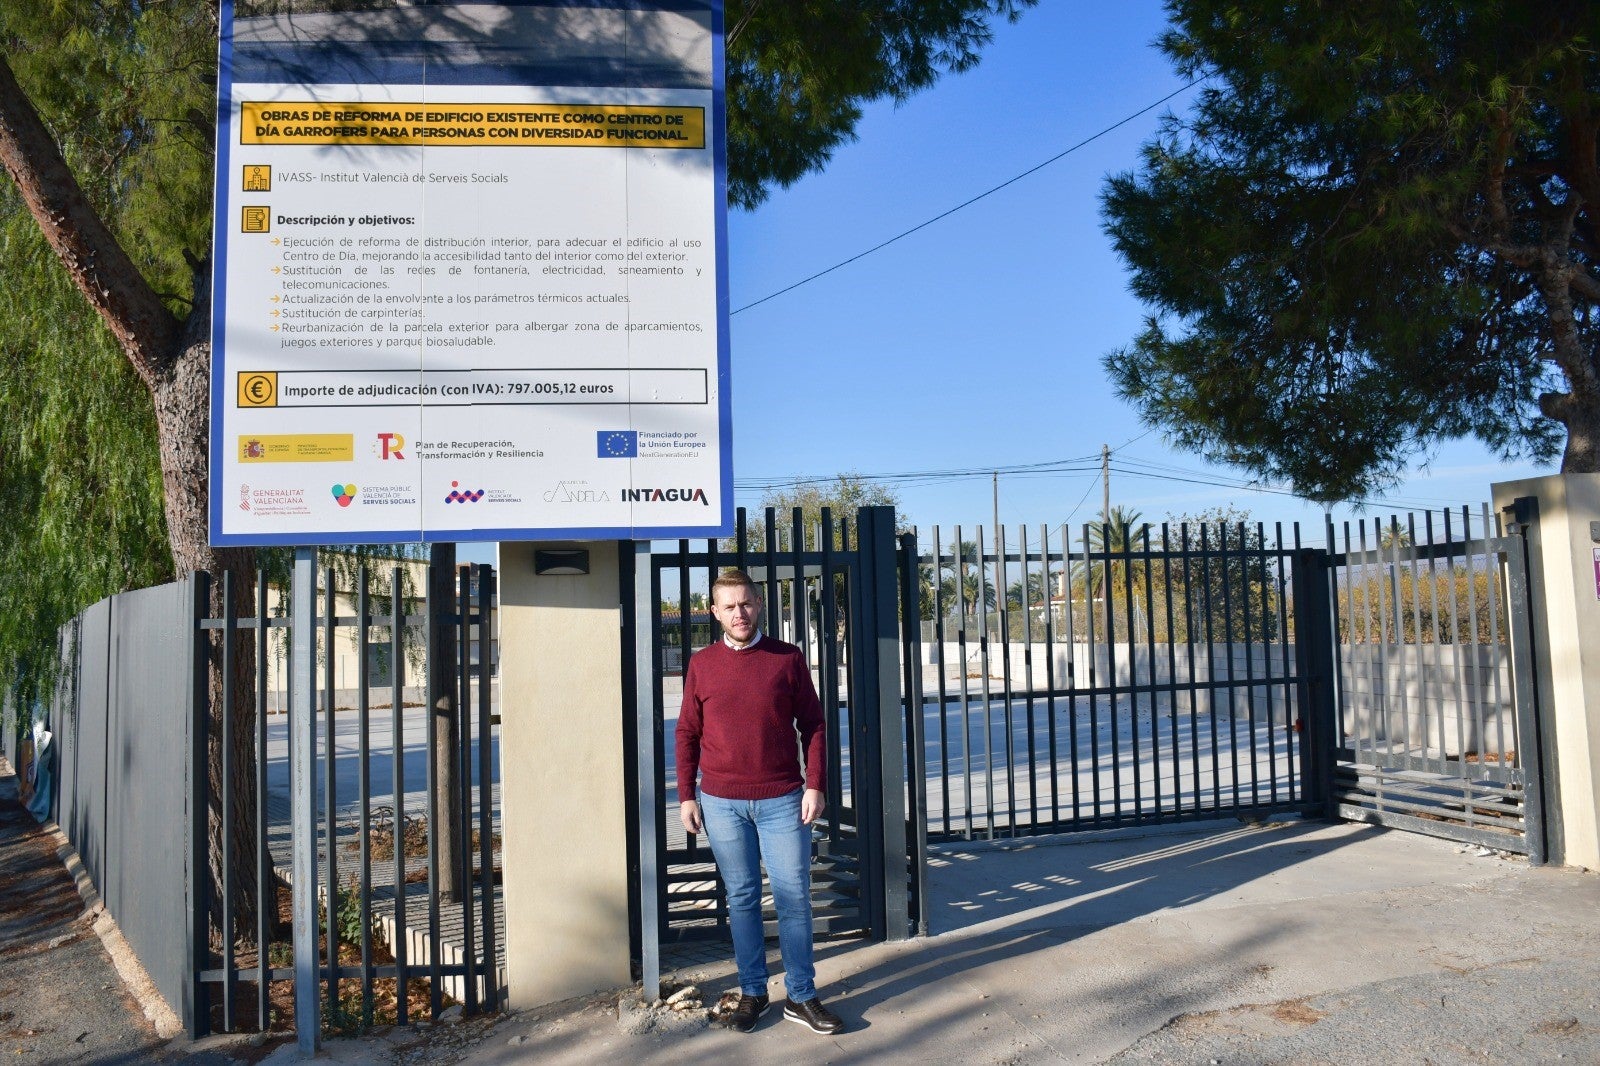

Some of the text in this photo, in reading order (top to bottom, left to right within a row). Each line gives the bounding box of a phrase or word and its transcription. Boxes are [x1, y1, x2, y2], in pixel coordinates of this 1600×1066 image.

[261, 111, 683, 125] OBRAS DE REFORMA DE EDIFICIO EXISTENTE COMO CENTRO DE
[256, 124, 280, 136] DÍA
[283, 126, 368, 137] GARROFERS
[371, 127, 407, 137] PARA
[413, 127, 485, 138] PERSONAS
[489, 128, 518, 138] CON
[521, 129, 603, 139] DIVERSIDAD
[279, 173, 509, 183] IVASS- Institut Valencià de Serveis Socials
[278, 215, 415, 227] Descripción y objetivos:
[283, 237, 334, 249] Ejecución
[340, 238, 353, 247] de
[359, 238, 401, 247] reforma
[406, 238, 419, 247] de
[425, 238, 485, 247] distribución
[491, 238, 531, 247] interior,
[537, 240, 560, 249] para
[565, 238, 607, 247] adecuar
[613, 238, 622, 247] el
[627, 238, 663, 247] edificio
[670, 238, 678, 247] al
[283, 252, 318, 261] Centro
[322, 252, 335, 261] de
[339, 252, 359, 262] Día,
[362, 252, 418, 263] mejorando
[422, 252, 431, 261] la
[434, 252, 501, 261] accesibilidad
[504, 253, 532, 261] tanto
[536, 252, 551, 261] del
[555, 252, 591, 261] interior
[627, 252, 642, 261] del
[646, 252, 688, 261] exterior.
[283, 266, 342, 275] Sustitución
[355, 266, 368, 274] de
[380, 266, 394, 274] las
[407, 266, 435, 274] redes
[448, 266, 461, 274] de
[474, 266, 530, 275] fontanería,
[542, 266, 606, 275] electricidad,
[619, 267, 683, 275] saneamiento
[283, 280, 390, 289] telecomunicaciones.
[283, 294, 353, 304] Actualización
[357, 294, 370, 303] de
[374, 294, 383, 303] la
[386, 294, 443, 303] envolvente
[457, 294, 471, 303] los
[474, 294, 534, 305] parámetros
[538, 294, 582, 303] térmicos
[587, 294, 630, 303] actuales.
[282, 309, 425, 320] Sustitución de carpinterías.
[282, 323, 364, 332] Reurbanización
[371, 323, 383, 331] de
[389, 323, 398, 331] la
[404, 323, 442, 334] parcela
[449, 323, 489, 331] exterior
[495, 324, 519, 334] para
[525, 322, 568, 334] albergar
[606, 322, 619, 331] de
[625, 323, 703, 334] aparcamientos,
[281, 337, 495, 349] juegos exteriores y parque biosaludable.
[285, 383, 614, 399] Importe de adjudicación (con IVA): 797.005,12 euros
[639, 431, 682, 439] Financiado
[437, 441, 449, 449] de
[452, 441, 515, 450] Recuperación,
[649, 440, 671, 448] Unión
[674, 441, 706, 449] Europea
[417, 450, 544, 459] Transformación y Resiliencia
[253, 489, 304, 497] GENERALITAT
[622, 488, 709, 506] INTAGUA
